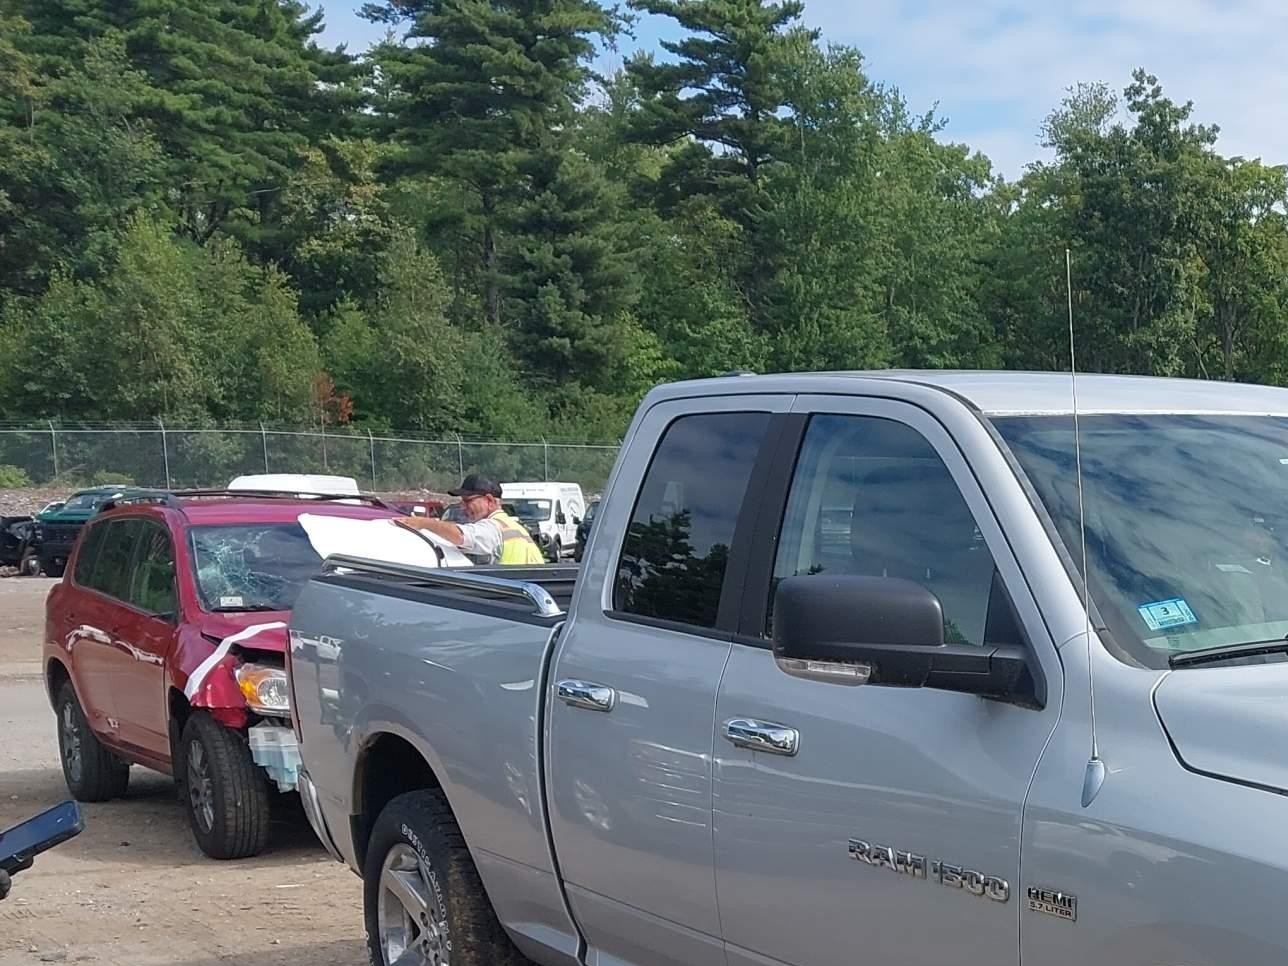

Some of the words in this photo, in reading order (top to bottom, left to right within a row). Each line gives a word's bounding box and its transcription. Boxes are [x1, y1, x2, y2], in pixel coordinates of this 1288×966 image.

[848, 837, 927, 880] RAM
[931, 859, 1010, 903] 1500
[1027, 887, 1073, 908] HEMI
[1030, 901, 1043, 910] 5.7
[1045, 905, 1072, 917] LITER
